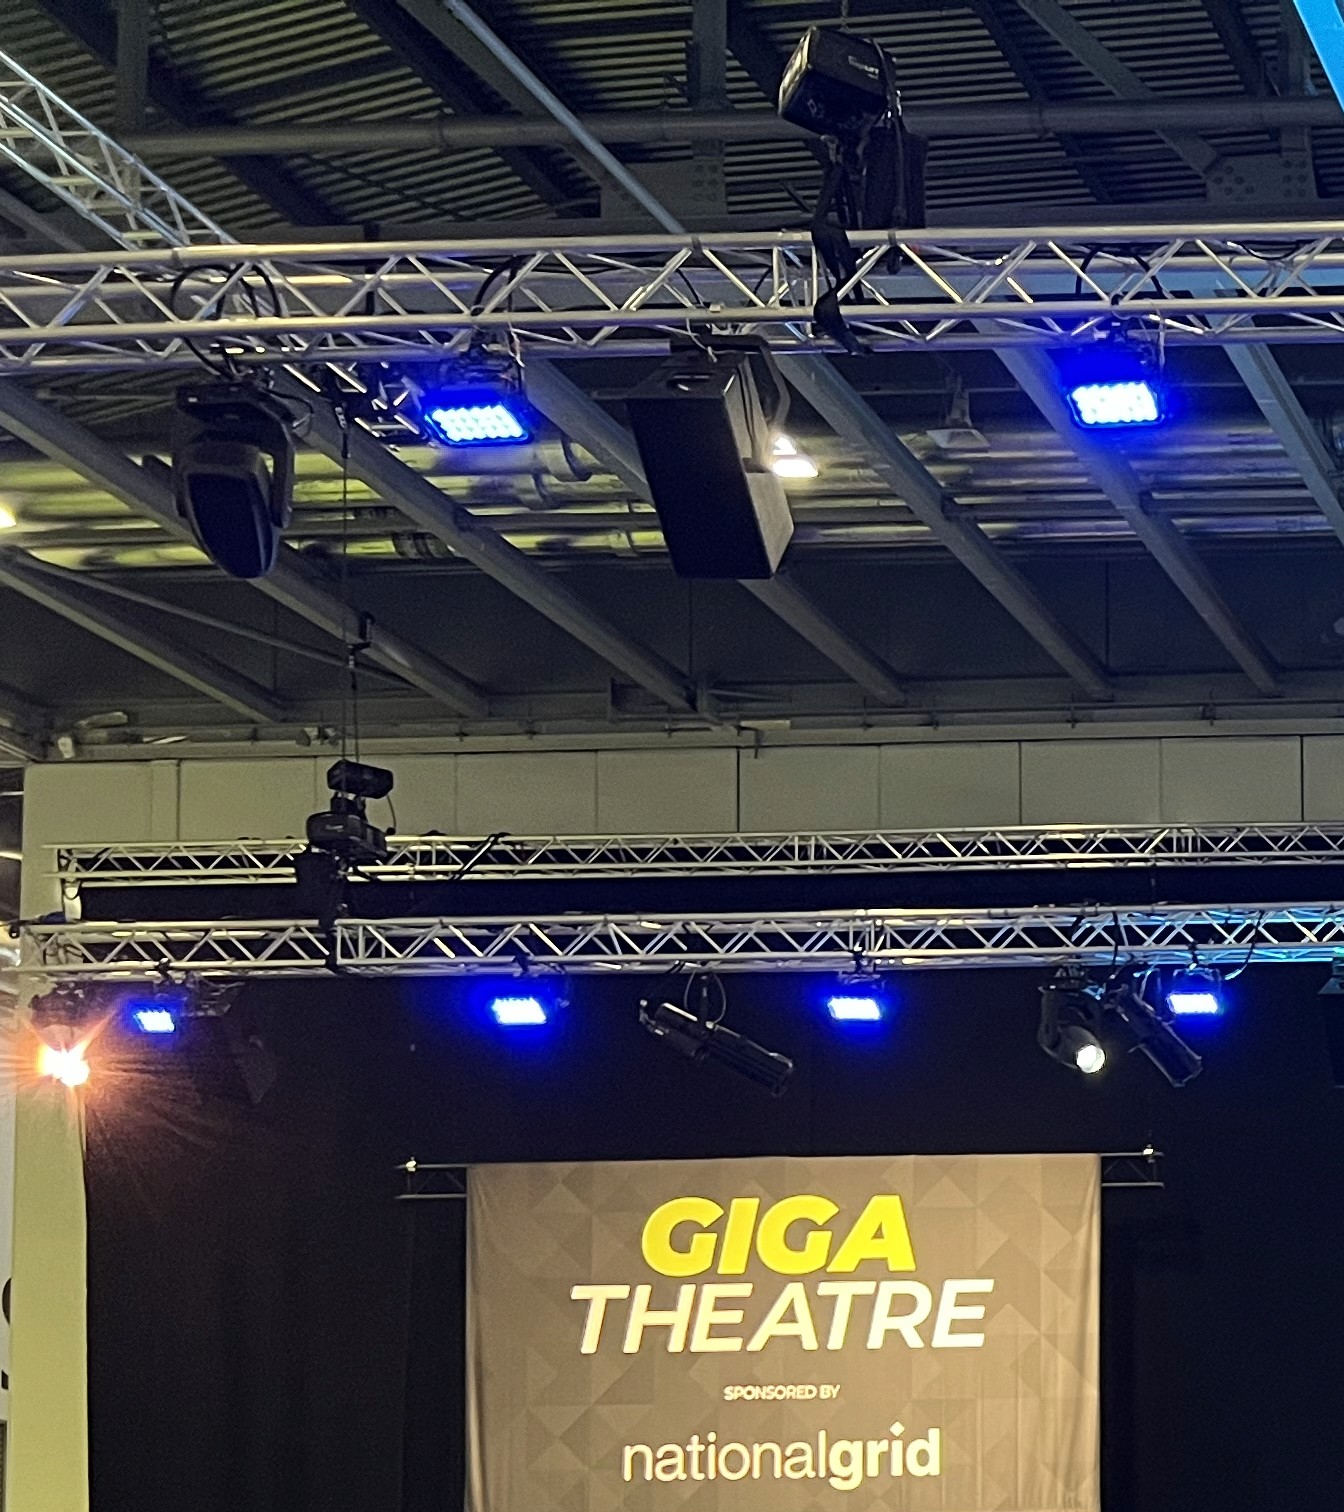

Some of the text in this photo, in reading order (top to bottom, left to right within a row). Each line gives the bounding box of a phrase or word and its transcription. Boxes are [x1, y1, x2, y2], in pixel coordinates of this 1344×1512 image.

[641, 1195, 917, 1277] GIGA
[570, 1279, 994, 1354] THEATRE
[723, 1384, 841, 1400] SPONSORED BY
[623, 1422, 940, 1490] nationalgrid
